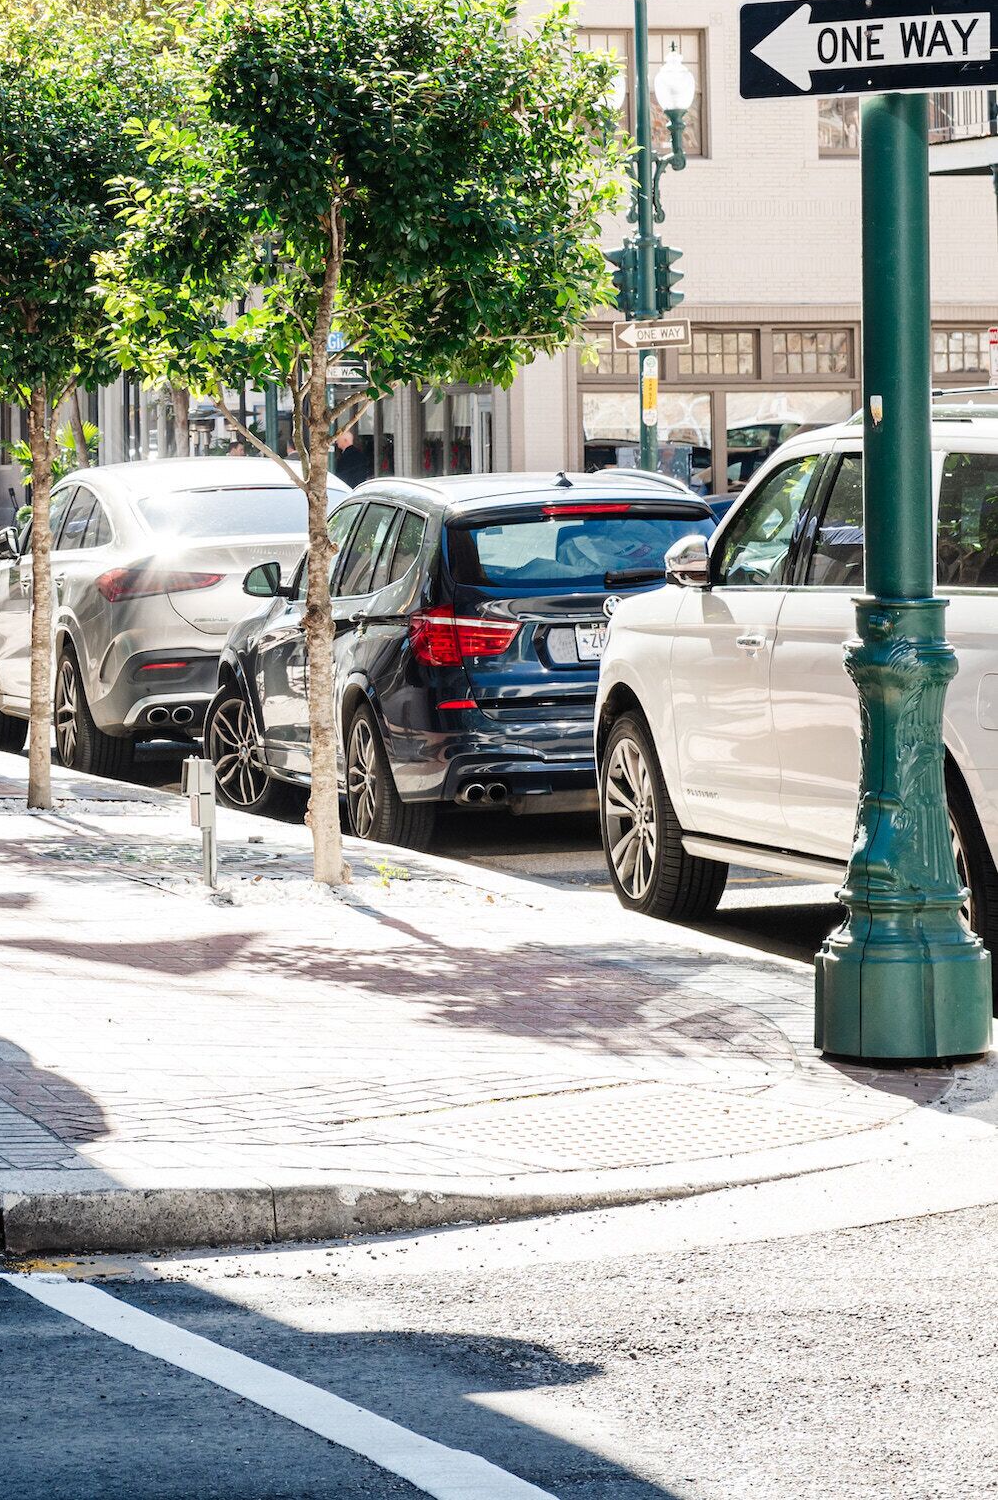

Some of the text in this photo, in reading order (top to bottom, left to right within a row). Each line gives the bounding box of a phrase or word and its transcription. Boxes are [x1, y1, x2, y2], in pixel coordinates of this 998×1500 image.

[817, 18, 979, 65] ONE WAY
[637, 327, 681, 340] ONE WAY
